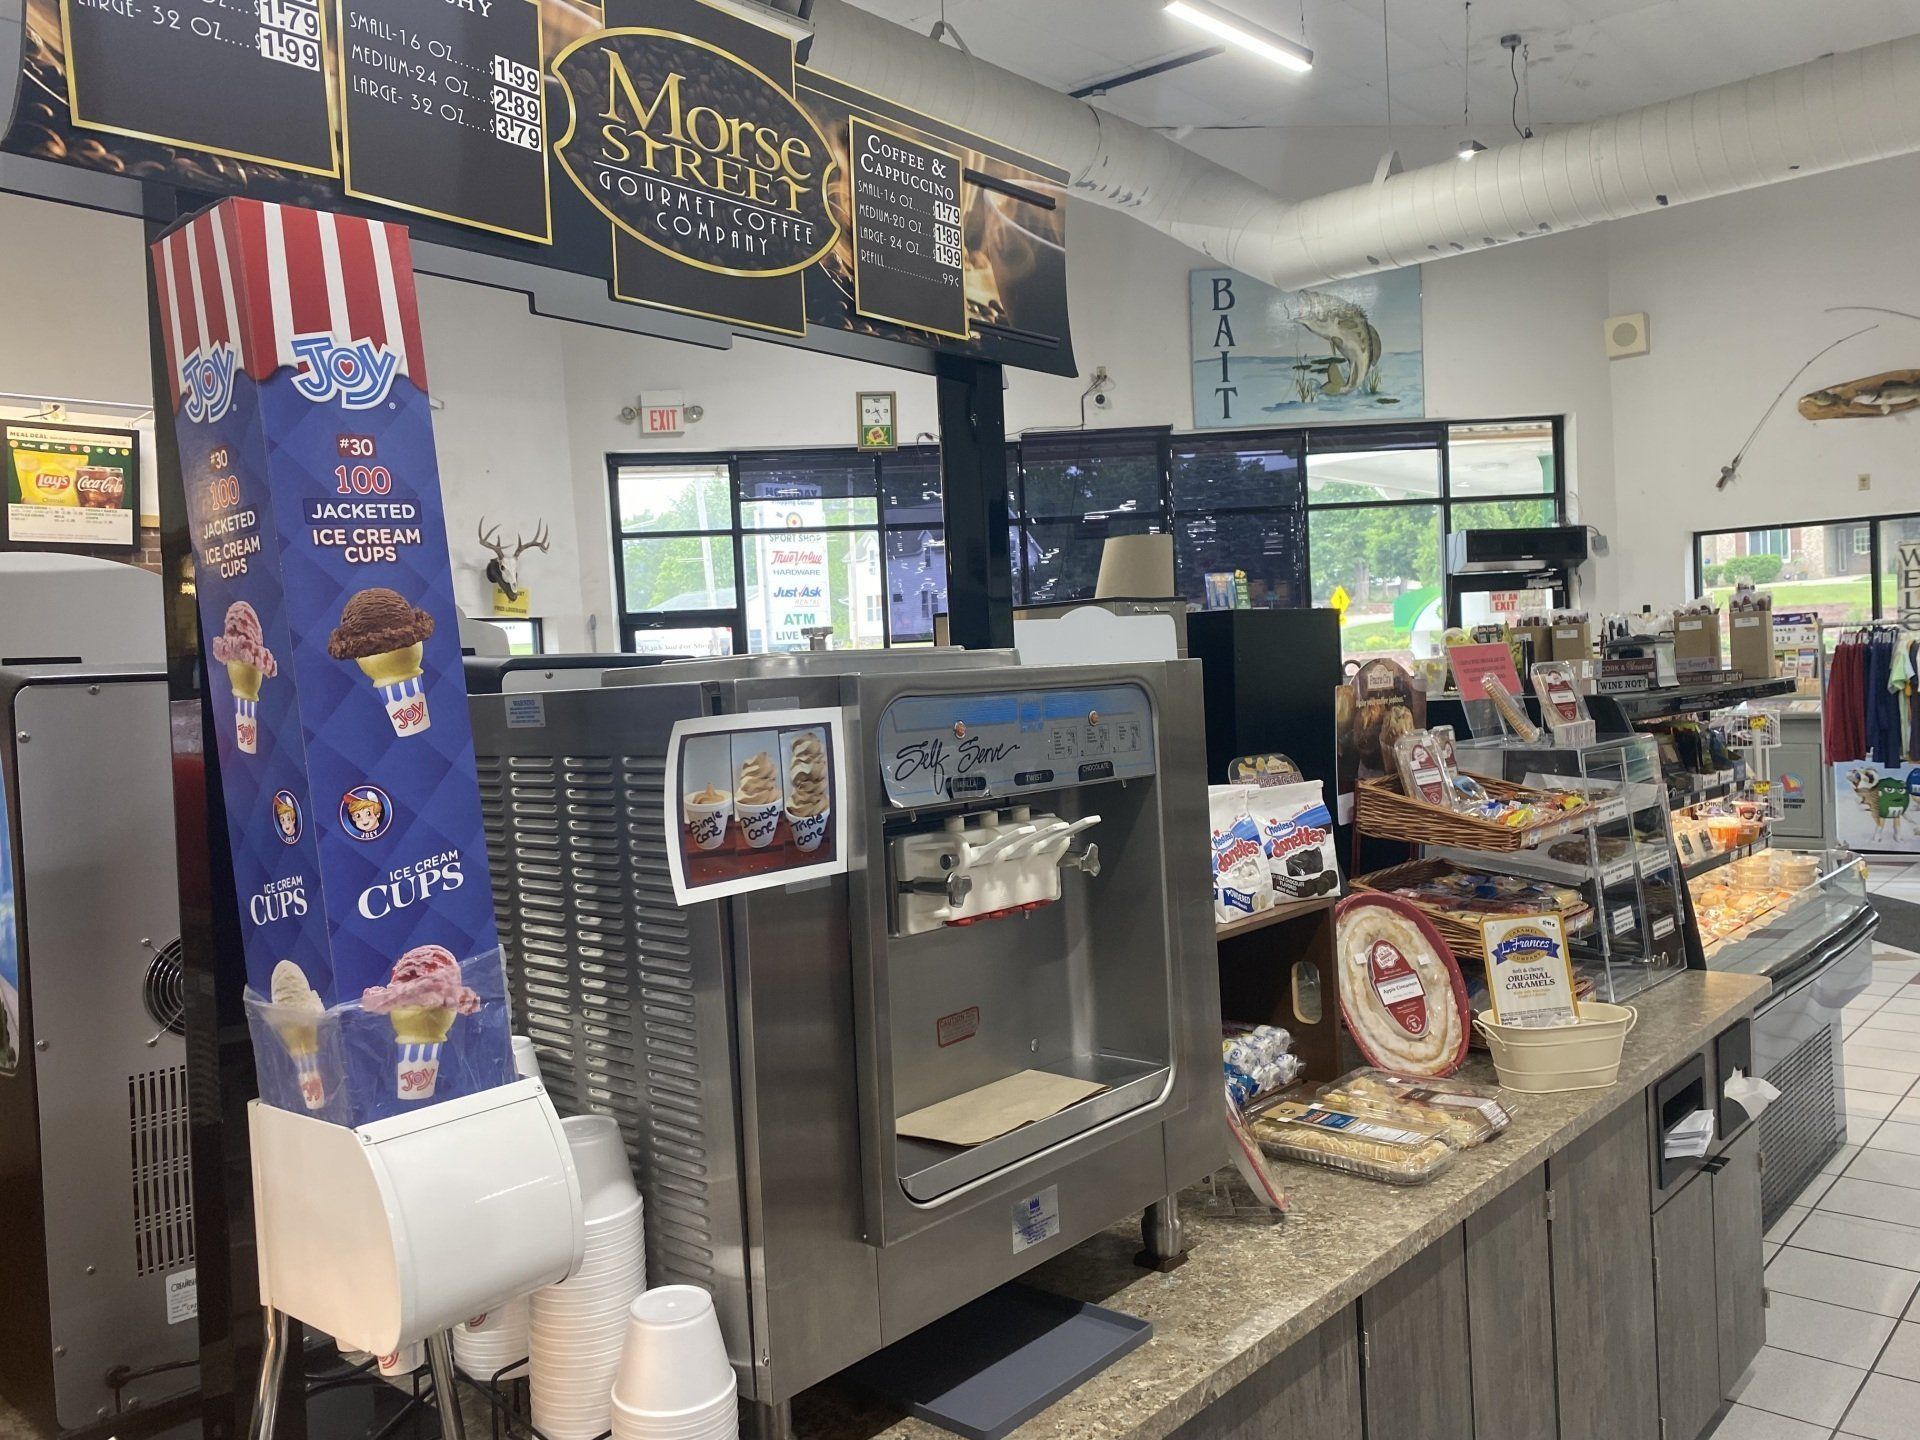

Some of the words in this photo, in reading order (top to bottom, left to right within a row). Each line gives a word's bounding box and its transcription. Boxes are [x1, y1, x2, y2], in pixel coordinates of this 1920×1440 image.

[152, 5, 181, 30] 32
[350, 11, 421, 50] SMALL-16
[351, 44, 438, 86] MEDIUM-24
[353, 75, 404, 104] LARGE-
[411, 93, 433, 115] 32
[598, 47, 812, 180] Morse
[601, 123, 812, 213] STREET
[931, 158, 947, 179] &
[858, 179, 896, 204] SMALL-16
[599, 171, 715, 218] GOURMET
[733, 208, 812, 245] COFFEE
[859, 203, 905, 229] MEDIUM-20
[656, 212, 768, 256] COMPANY
[860, 226, 887, 245] LARGE-
[890, 235, 903, 251] 24
[1212, 278, 1239, 419] BAIT
[649, 409, 678, 431] EXIT
[339, 438, 374, 456] #30
[210, 449, 228, 470] #30
[335, 465, 392, 495] 100
[209, 475, 240, 511] 100
[311, 502, 416, 519] JACKETED
[203, 510, 256, 540] JACKETED
[312, 529, 347, 546] ICE
[352, 528, 421, 545] CREAM
[205, 546, 223, 565] ICE
[223, 535, 261, 560] CREAM
[344, 546, 397, 563] CUPS
[220, 557, 248, 580] CUPS
[774, 586, 799, 598] Just
[800, 586, 822, 597] Ask
[1509, 593, 1518, 601] AN
[1495, 601, 1516, 611] EXIT
[784, 613, 816, 626] ATM
[775, 631, 800, 641] LIVE
[1600, 680, 1623, 691] WINE
[1625, 678, 1647, 689] NOT?
[895, 738, 950, 795] Self
[957, 736, 1020, 774] Serve
[1082, 762, 1110, 773] CHOCOLATE
[1025, 774, 1043, 782] TWIST
[689, 810, 723, 835] Single
[740, 805, 779, 828] Double
[790, 813, 824, 832] Triple
[361, 830, 378, 838] JOEY
[1269, 820, 1294, 836] Hostess
[1212, 832, 1234, 850] Hostess
[1272, 827, 1326, 858] donettes
[390, 865, 411, 882] ICE
[415, 850, 458, 872] CREAM
[263, 883, 276, 895] ICE
[277, 875, 303, 893] CREAM
[358, 862, 465, 920] CUPS
[250, 887, 308, 926] CUPS
[1226, 889, 1251, 904] POWDERED
[1510, 937, 1550, 952] Frances
[1505, 978, 1556, 990] CARAMELS
[1507, 972, 1551, 983] ORIGINAL
[1383, 987, 1396, 995] Apple
